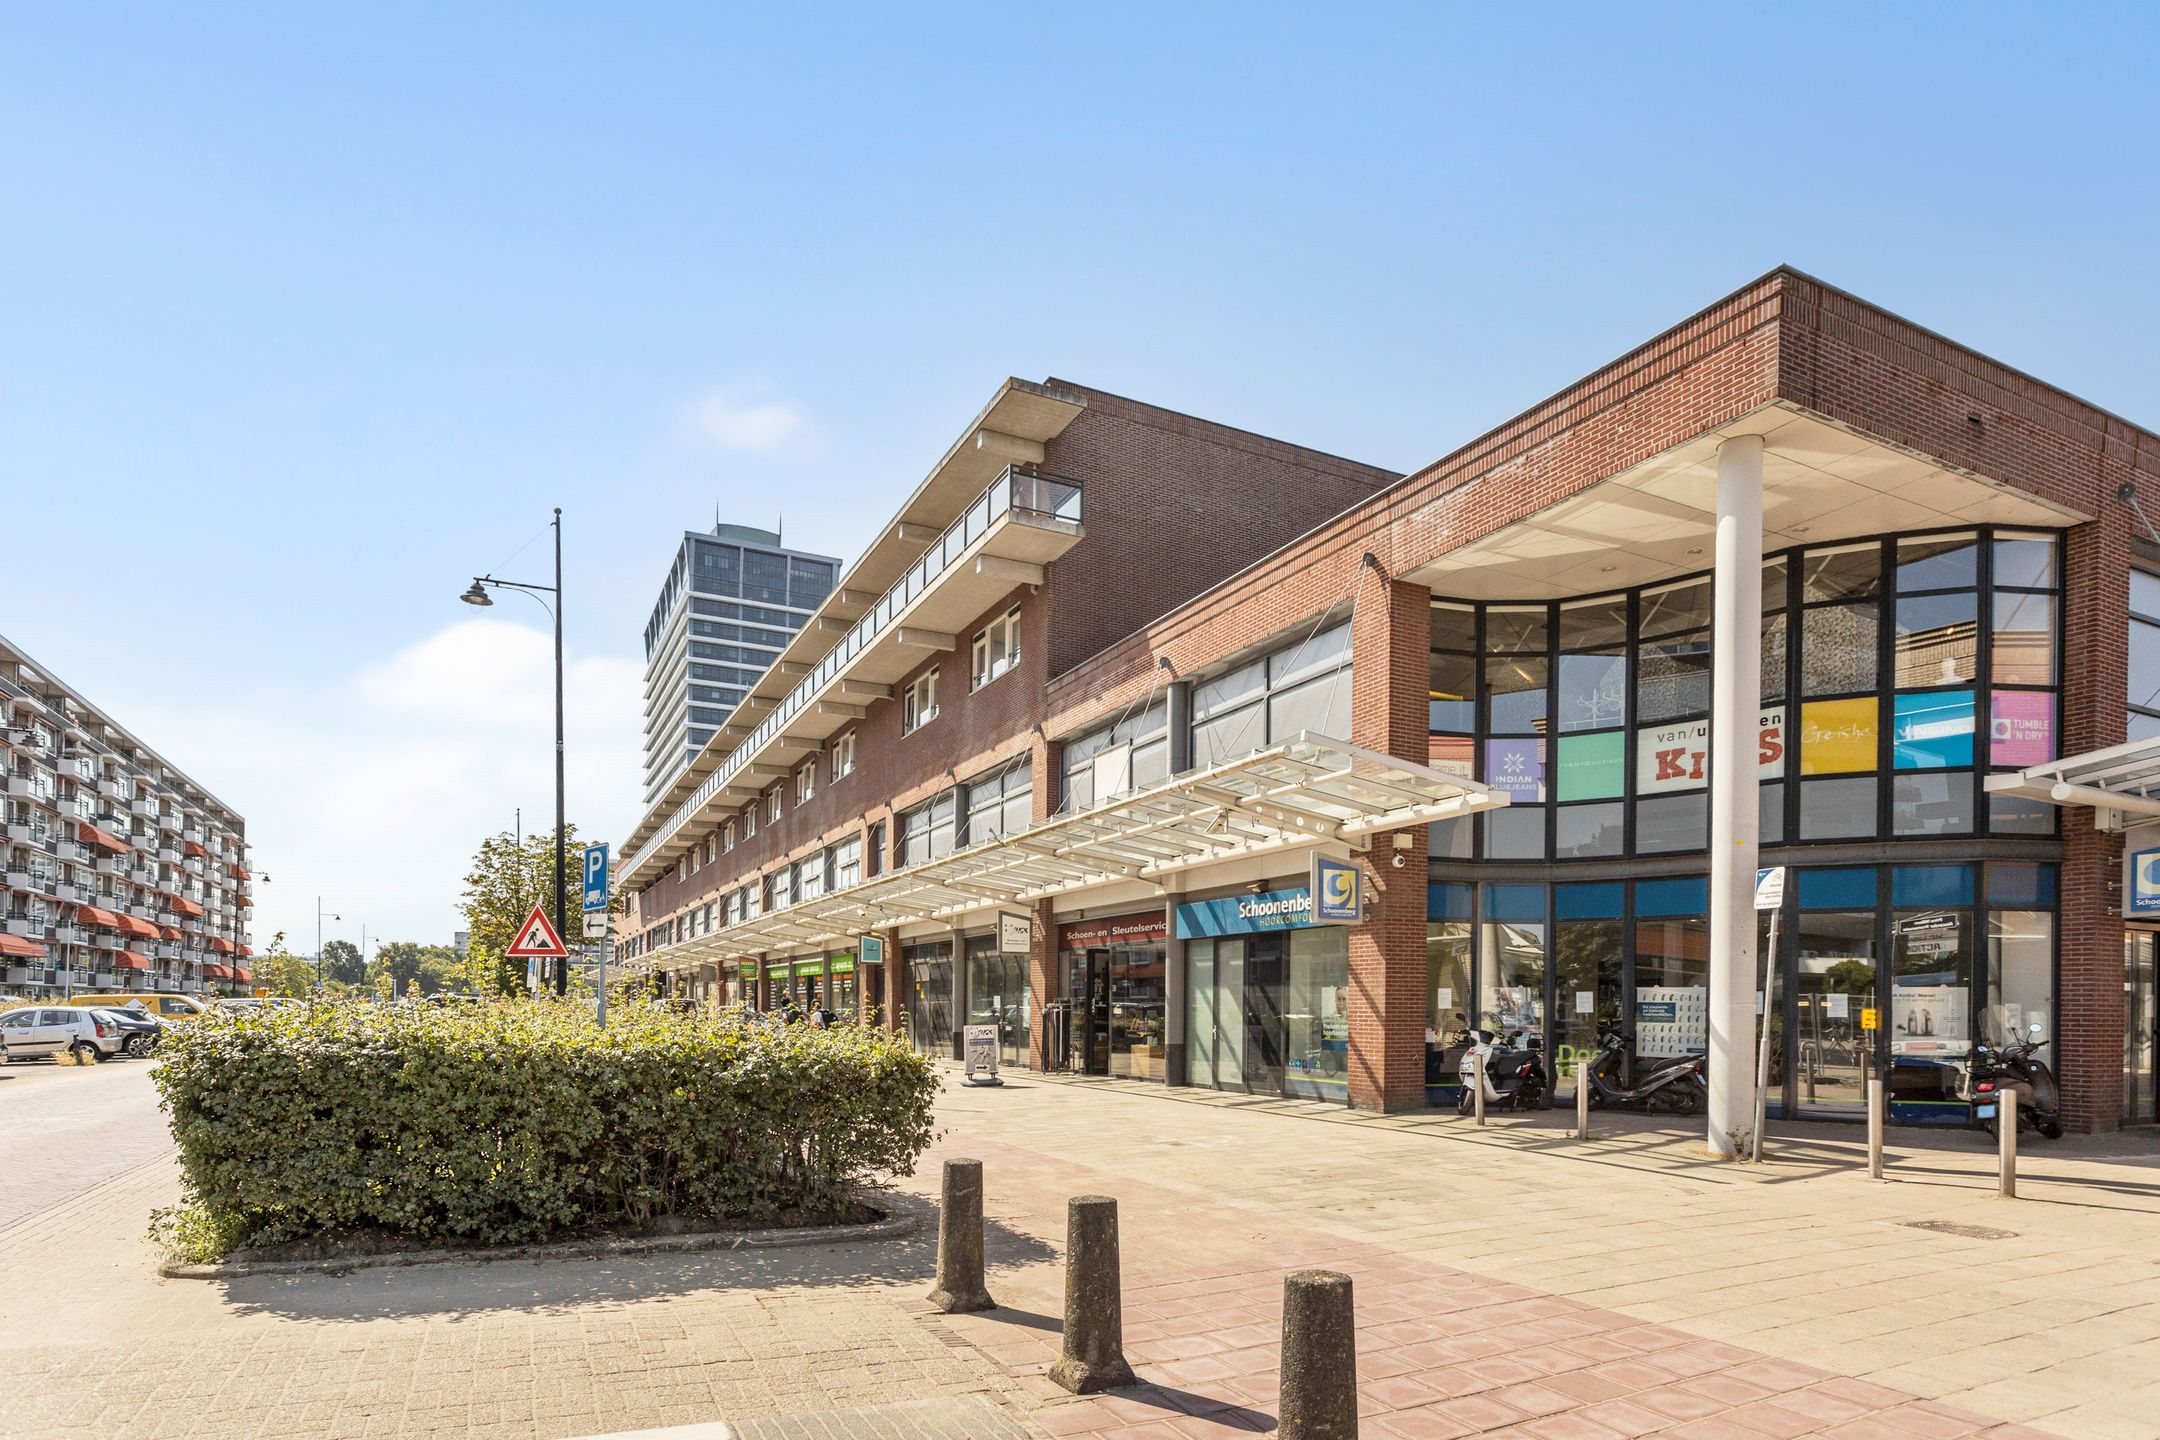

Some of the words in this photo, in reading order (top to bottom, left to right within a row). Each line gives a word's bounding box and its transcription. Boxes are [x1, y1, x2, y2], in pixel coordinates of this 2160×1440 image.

[2012, 719, 2050, 730] TUMBLE
[1801, 722, 1876, 744] Geisha
[1655, 727, 1783, 781] KIS
[1495, 775, 1533, 784] INDIAN
[589, 850, 603, 884] P
[1066, 931, 1096, 940] Schoen-
[1097, 929, 1108, 938] en
